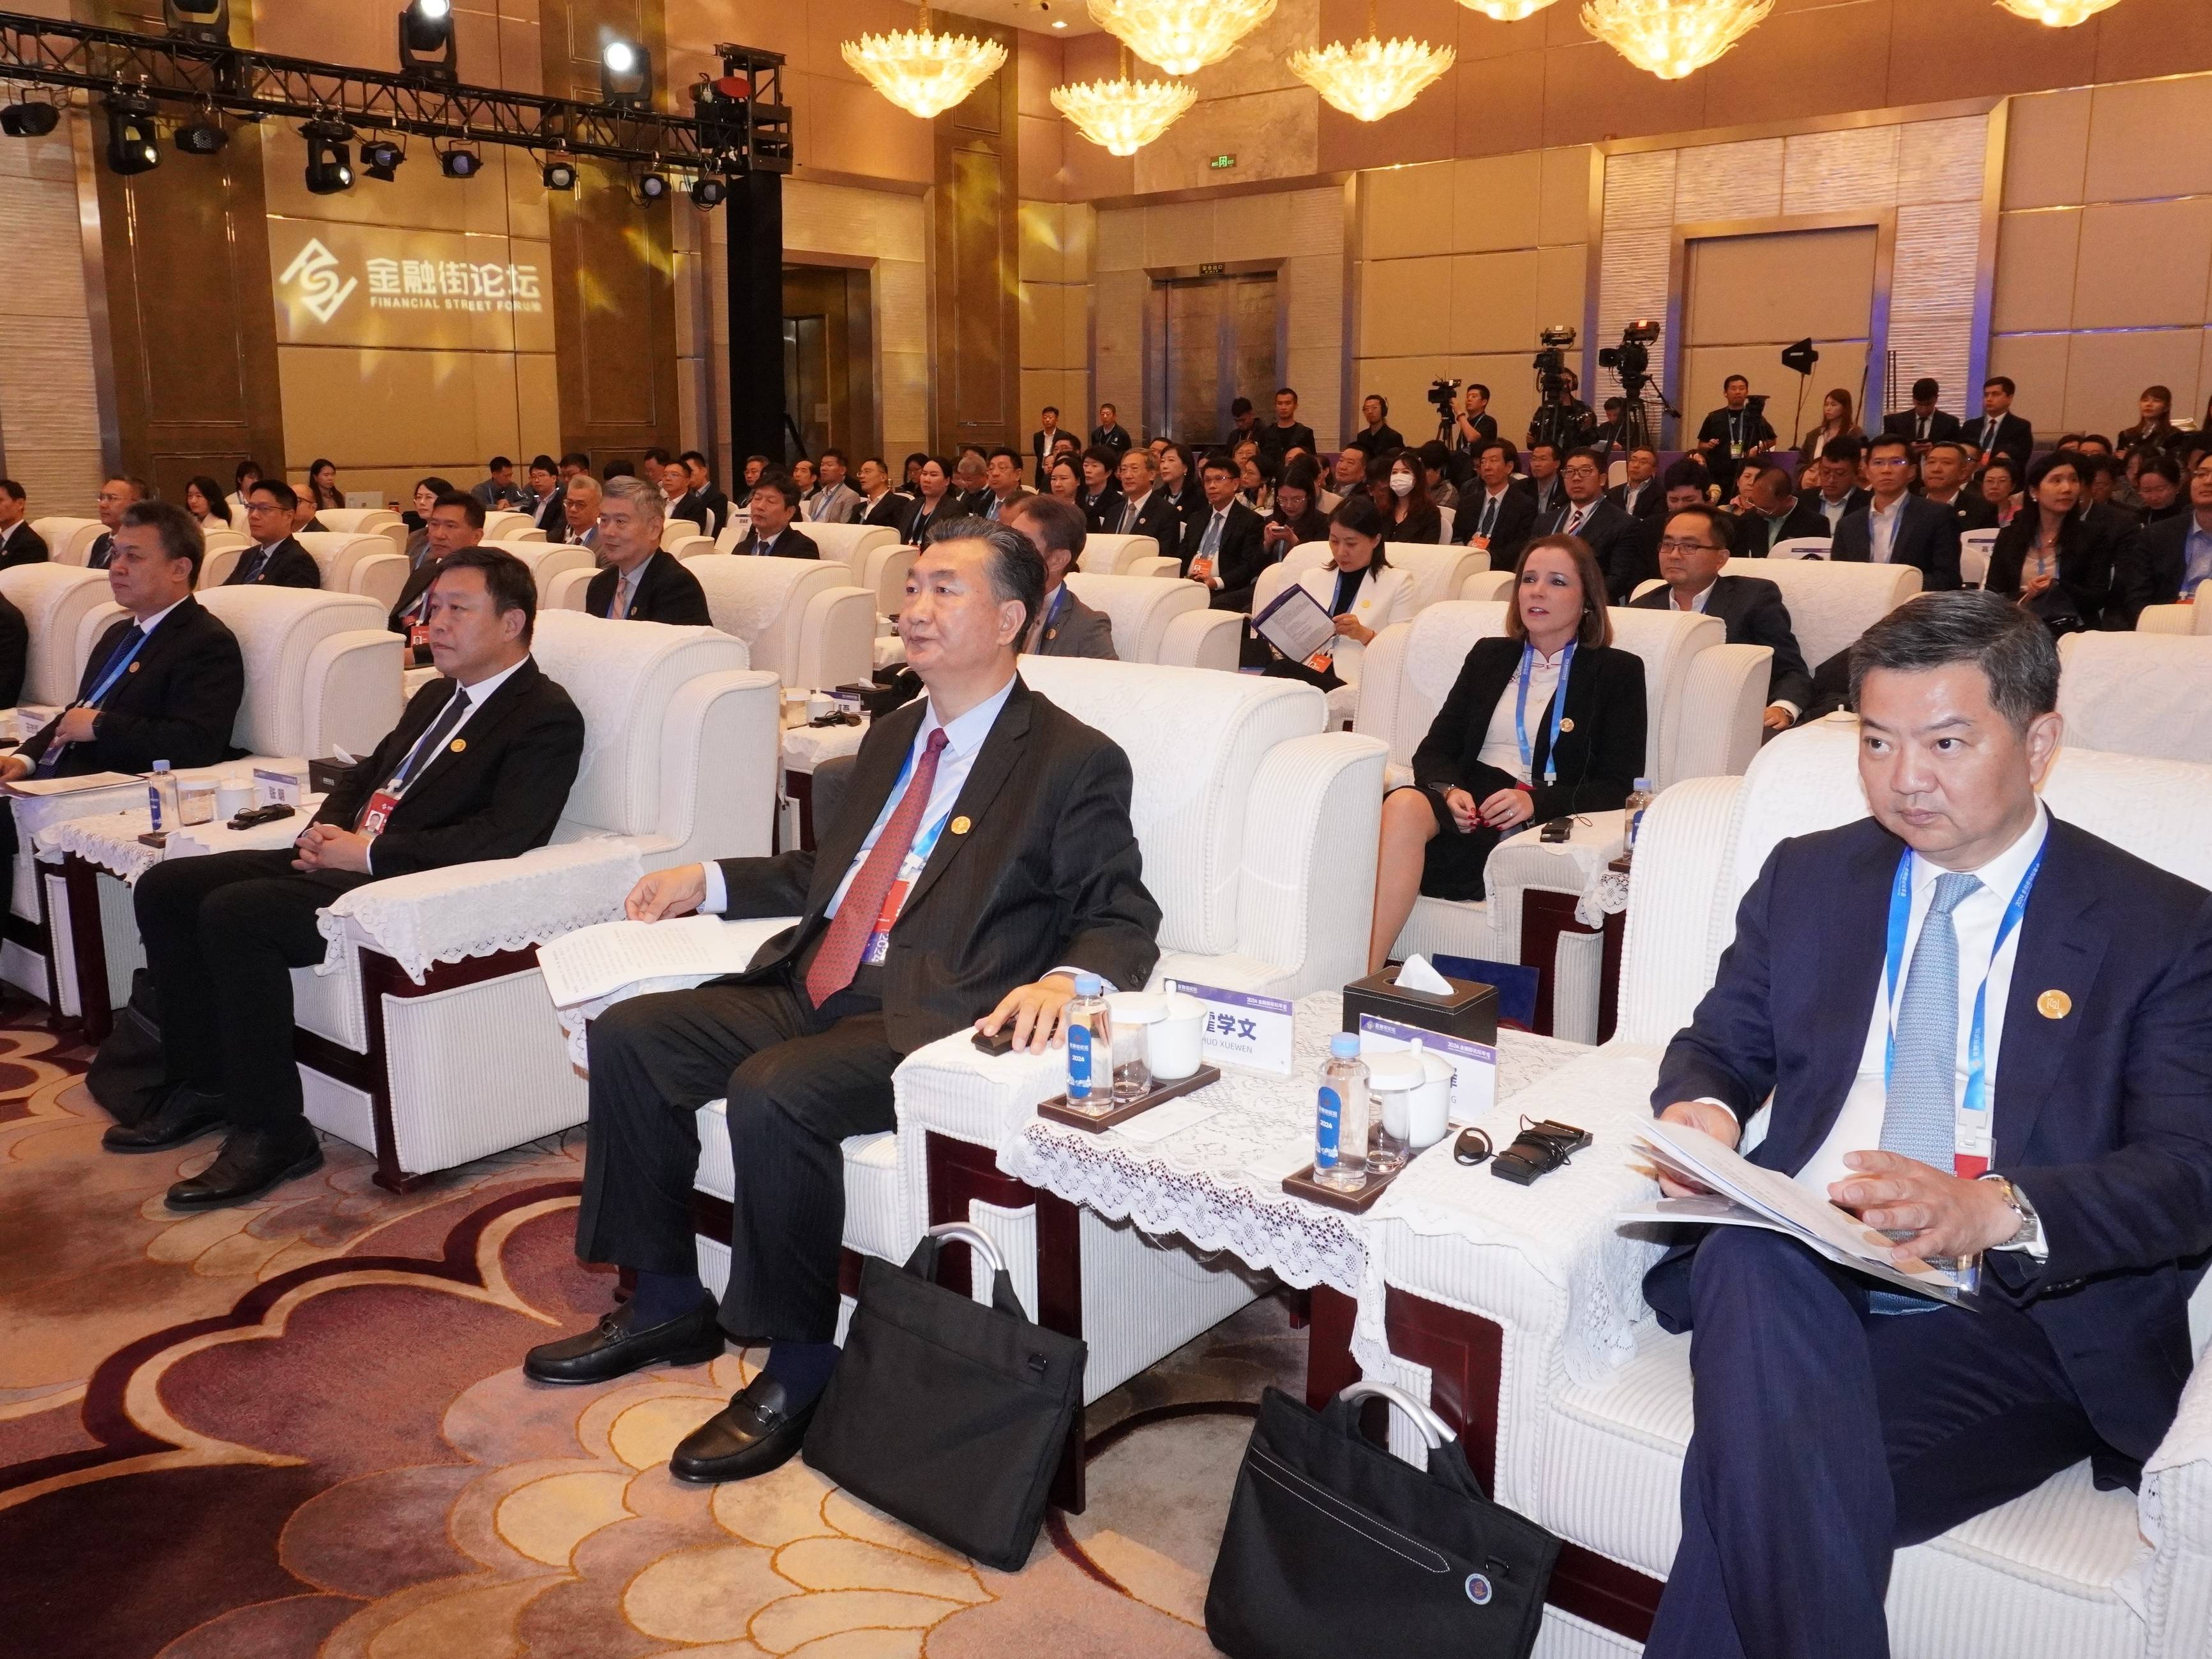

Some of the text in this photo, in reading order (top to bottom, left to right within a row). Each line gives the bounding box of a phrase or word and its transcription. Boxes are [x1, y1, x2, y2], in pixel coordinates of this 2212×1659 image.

[366, 257, 541, 298] 金融街论坛
[370, 296, 542, 312] FINANCIAL STREET FORUM
[1220, 1040, 1253, 1053] XUEWEN
[1320, 1120, 1333, 1129] 2024
